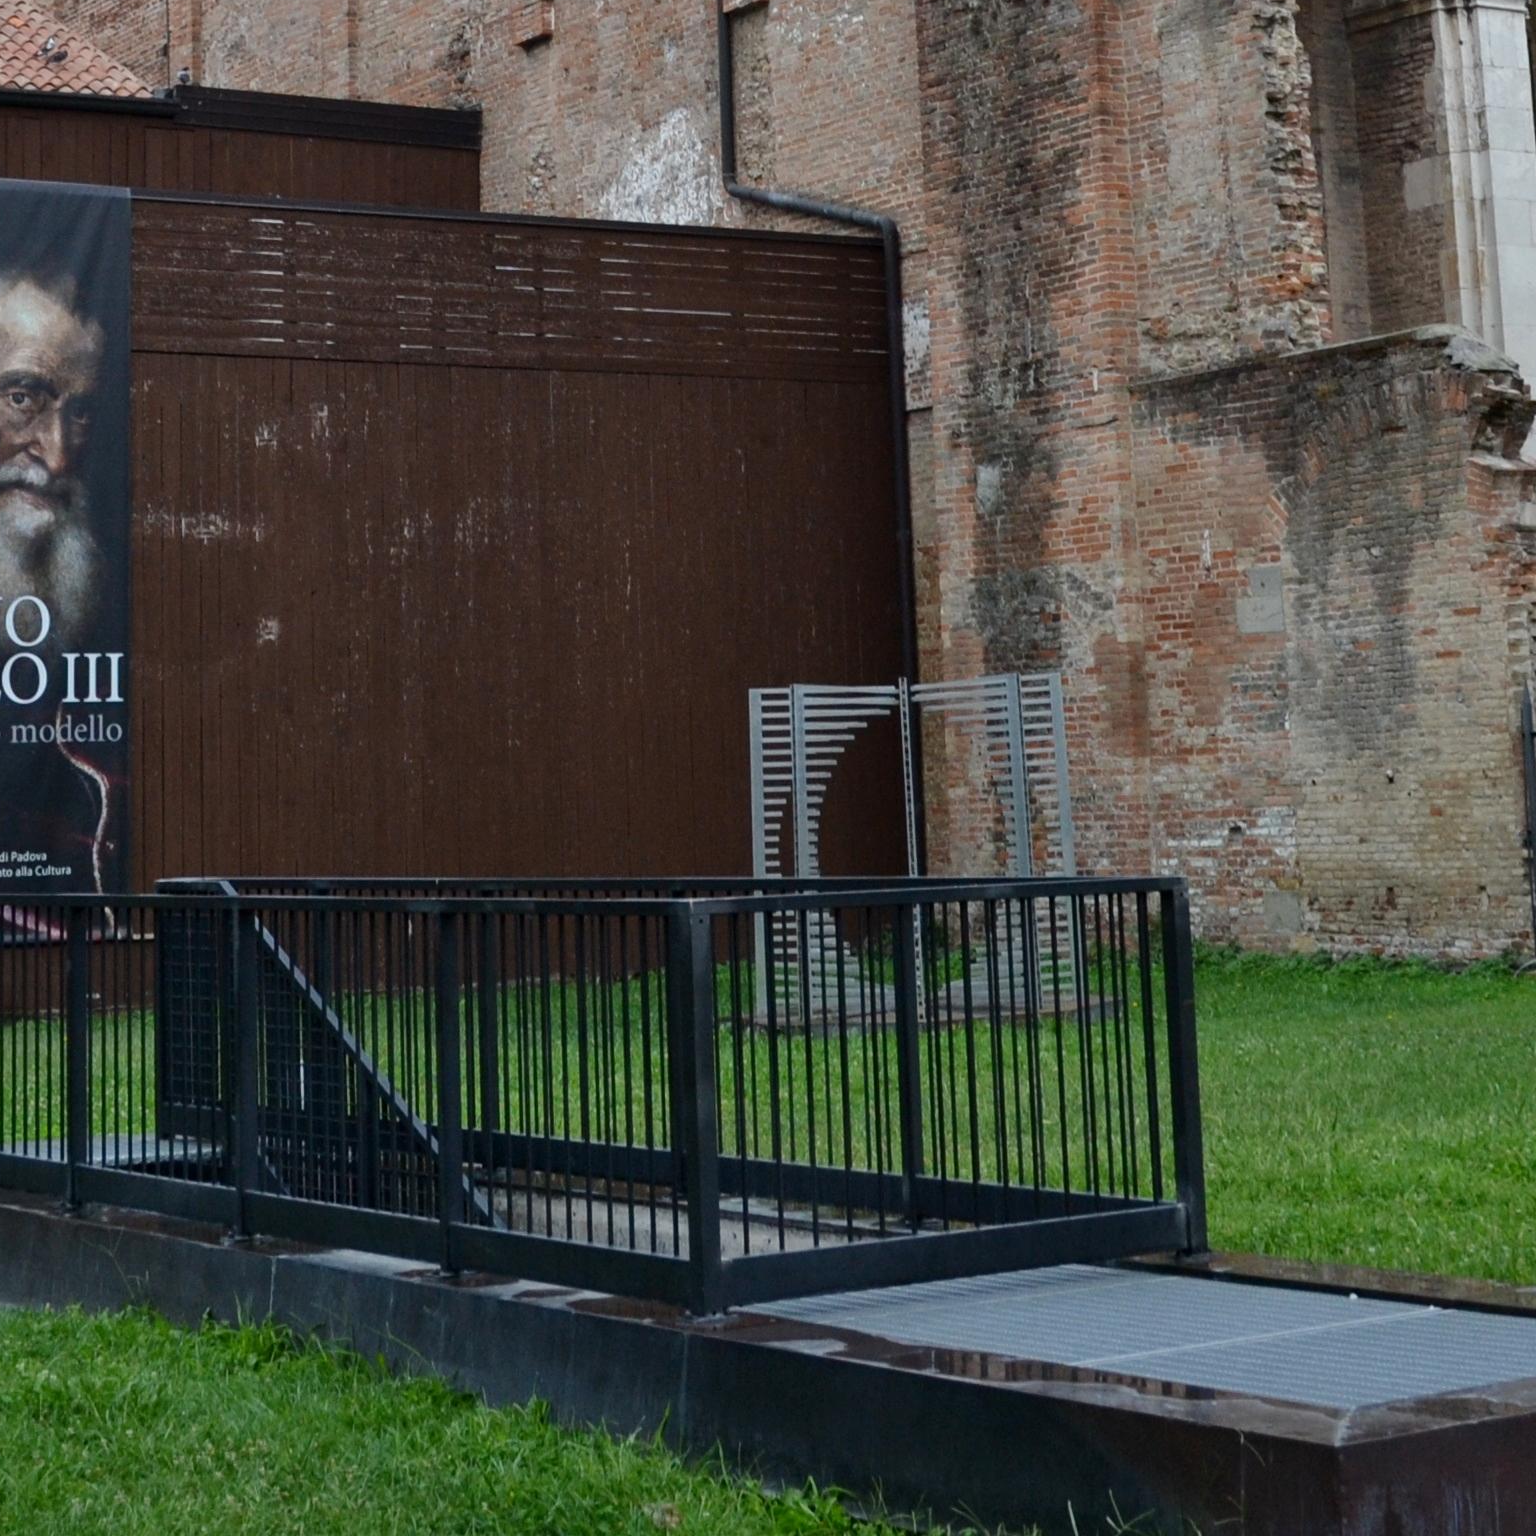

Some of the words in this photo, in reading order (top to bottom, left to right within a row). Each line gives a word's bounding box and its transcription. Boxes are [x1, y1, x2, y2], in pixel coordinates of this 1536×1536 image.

[61, 652, 124, 704] III
[10, 714, 124, 745] modello
[10, 851, 48, 863] Padova
[15, 866, 33, 877] alla
[35, 865, 73, 877] Cultura
